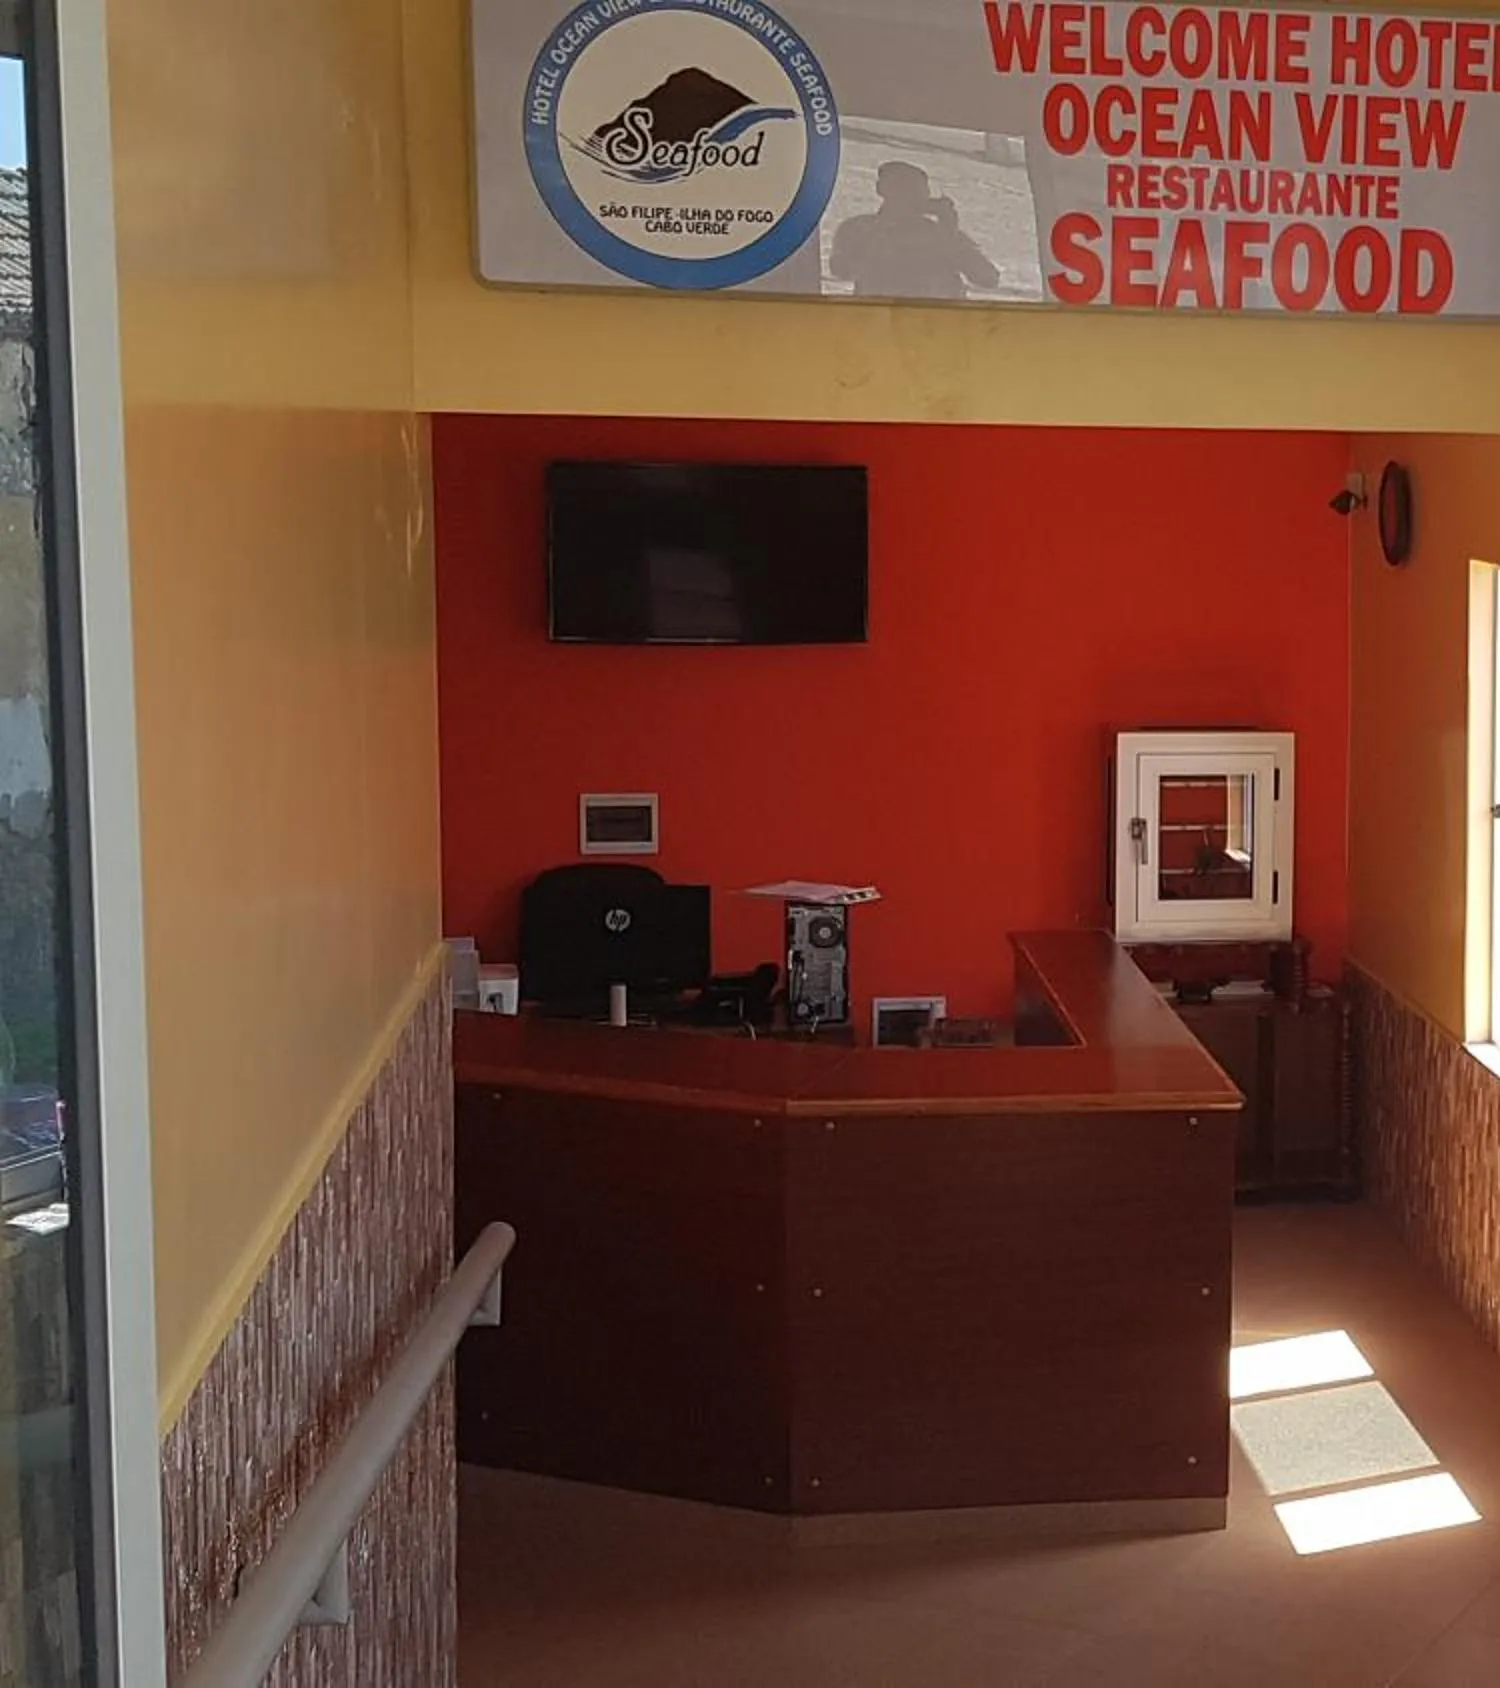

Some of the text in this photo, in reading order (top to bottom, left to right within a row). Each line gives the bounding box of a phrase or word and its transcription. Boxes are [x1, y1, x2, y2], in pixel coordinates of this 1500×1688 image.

[531, 68, 561, 125] HOTEL
[550, 11, 600, 65] OCEAN
[790, 52, 833, 136] SEAFOOD
[984, 0, 1312, 85] WELCOME
[605, 108, 765, 177] Seafood
[1043, 82, 1468, 170] OCEAN VIEW
[599, 201, 628, 218] SÃO
[715, 209, 734, 222] DO
[737, 210, 774, 223] FOGO
[645, 219, 730, 235] CABO VERDE
[1106, 164, 1400, 221] RESTAURANTE
[1049, 213, 1455, 315] SEAFOOD
[607, 908, 630, 931] hp
